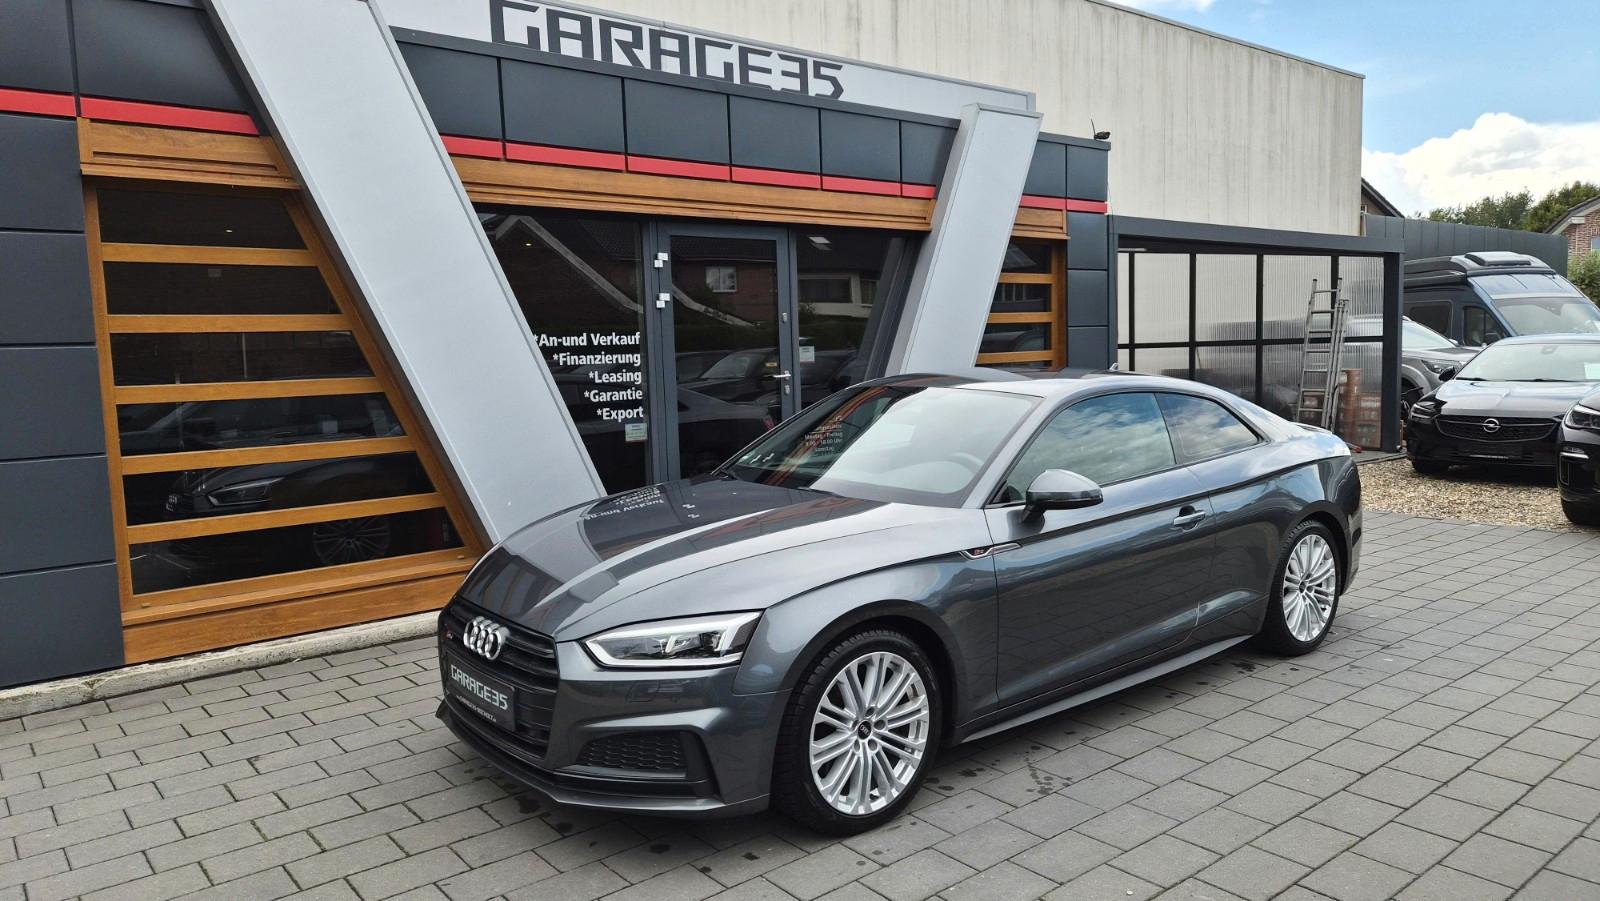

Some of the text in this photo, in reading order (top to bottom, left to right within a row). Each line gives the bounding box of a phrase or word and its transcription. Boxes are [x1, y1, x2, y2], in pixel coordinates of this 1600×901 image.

[490, 0, 844, 101] GARAGE35
[590, 332, 641, 346] Verkauf
[450, 663, 509, 710] GARAGE35
